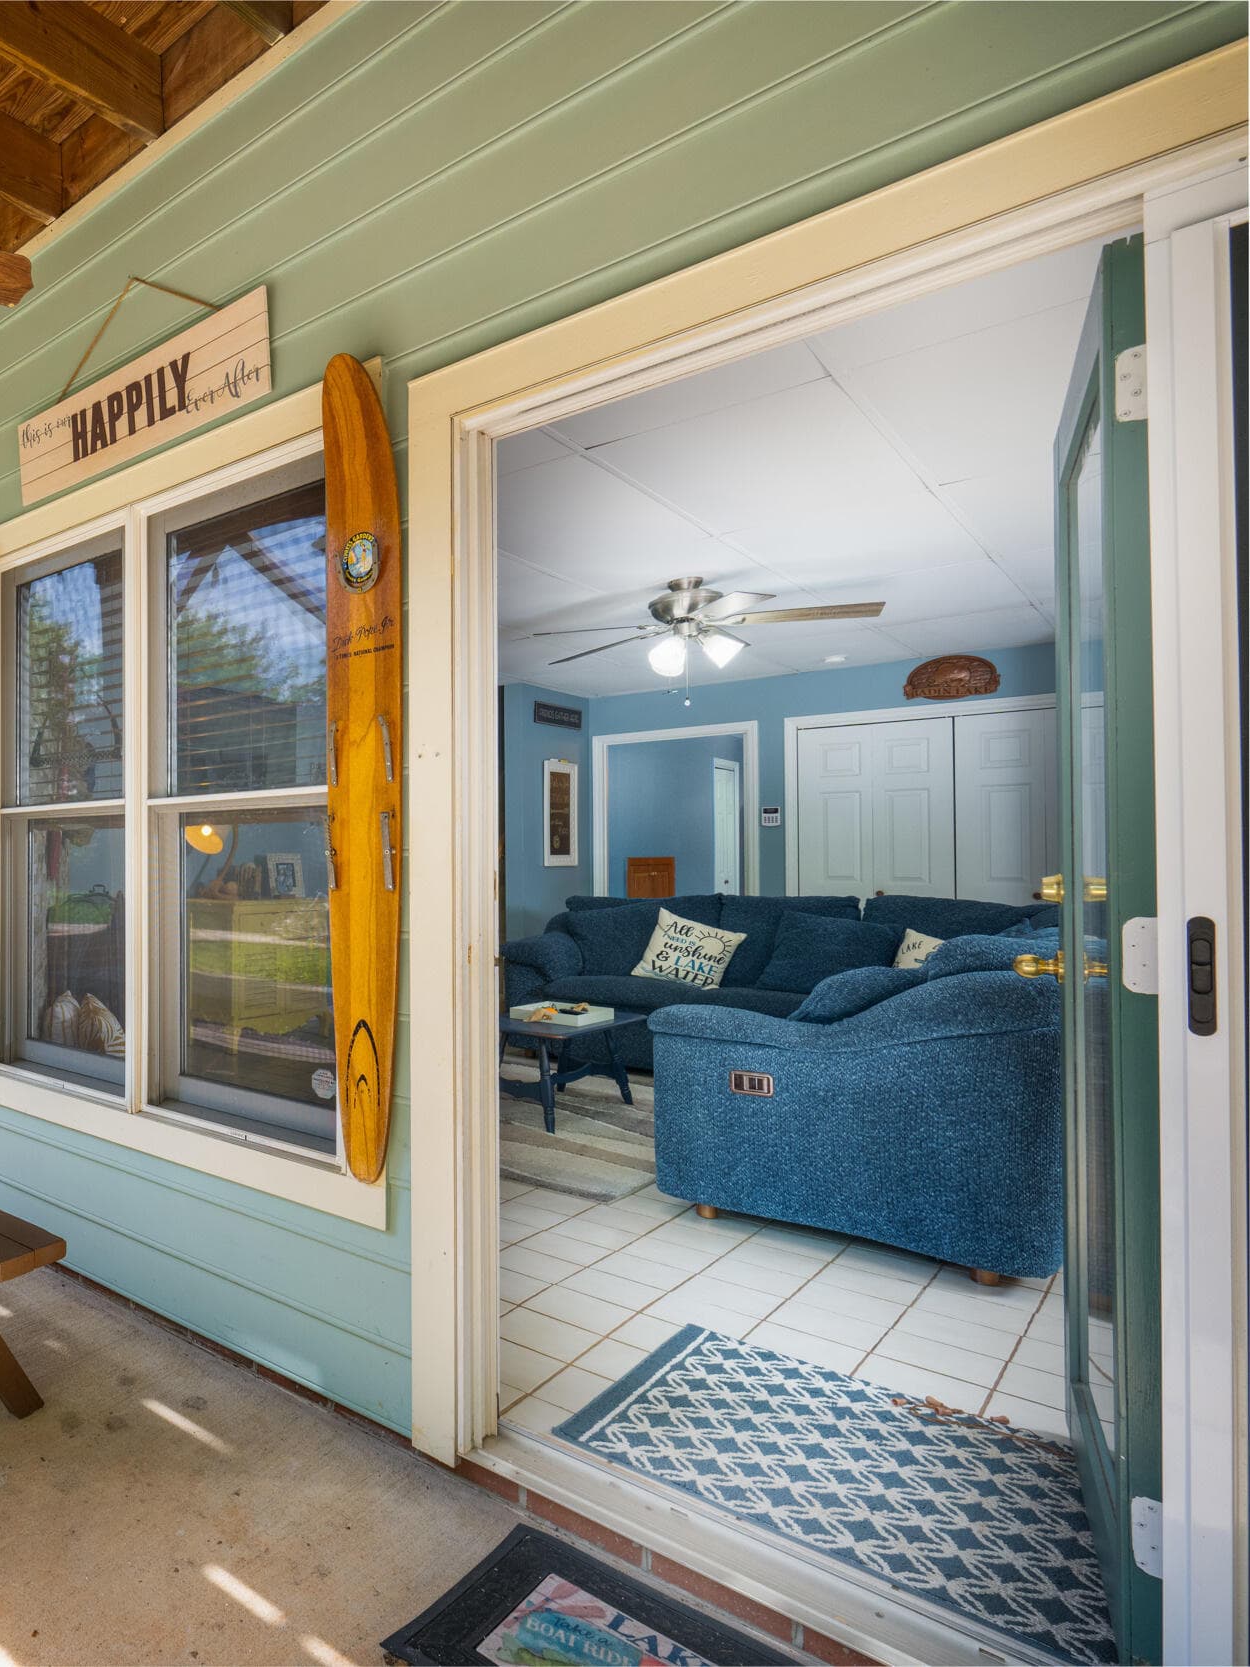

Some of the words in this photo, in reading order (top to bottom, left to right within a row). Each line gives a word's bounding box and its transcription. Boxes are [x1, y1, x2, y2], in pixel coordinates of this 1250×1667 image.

[22, 423, 41, 448] this
[44, 422, 53, 438] is
[71, 352, 190, 462] HAPPILY
[186, 387, 215, 414] Ever
[217, 358, 260, 399] After
[664, 921, 695, 938] All
[901, 940, 924, 955] LAKE
[651, 959, 718, 988] WATER
[675, 955, 719, 977] LAKE
[525, 1616, 580, 1648] BOAT
[553, 1616, 595, 1639] Take
[607, 1611, 712, 1667] LAK
